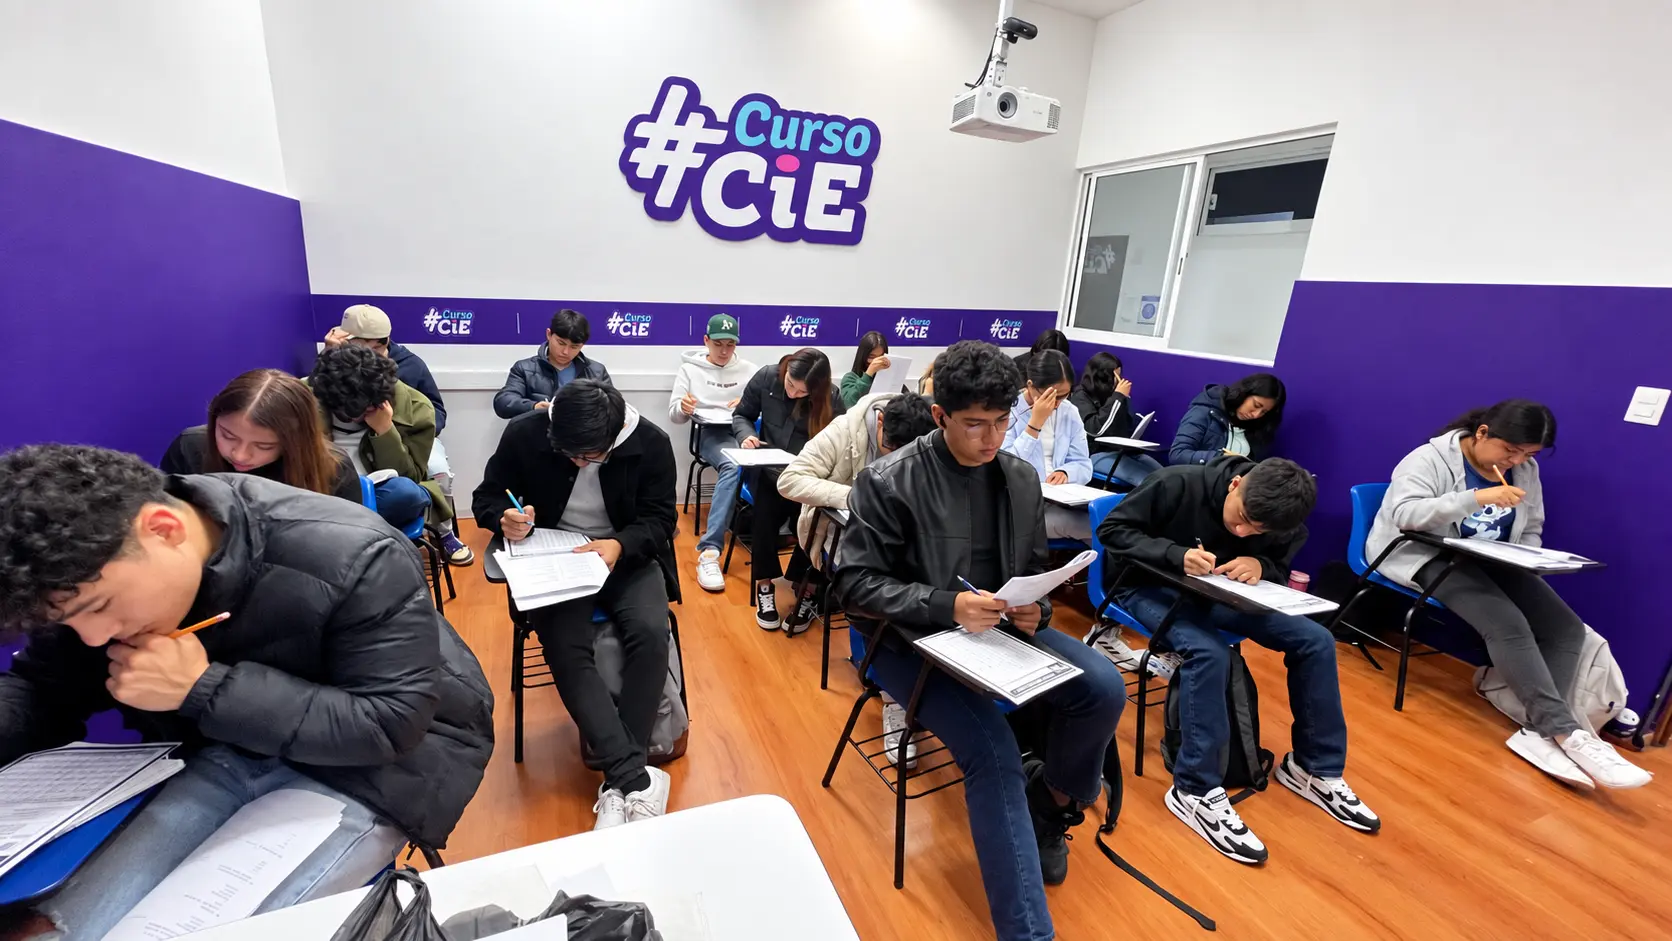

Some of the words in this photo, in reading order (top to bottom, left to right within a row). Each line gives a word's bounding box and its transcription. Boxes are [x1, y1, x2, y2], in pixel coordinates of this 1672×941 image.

[735, 100, 872, 157] Curso
[442, 309, 473, 319] Curso
[625, 312, 652, 322] Curso
[796, 316, 820, 324] Curso
